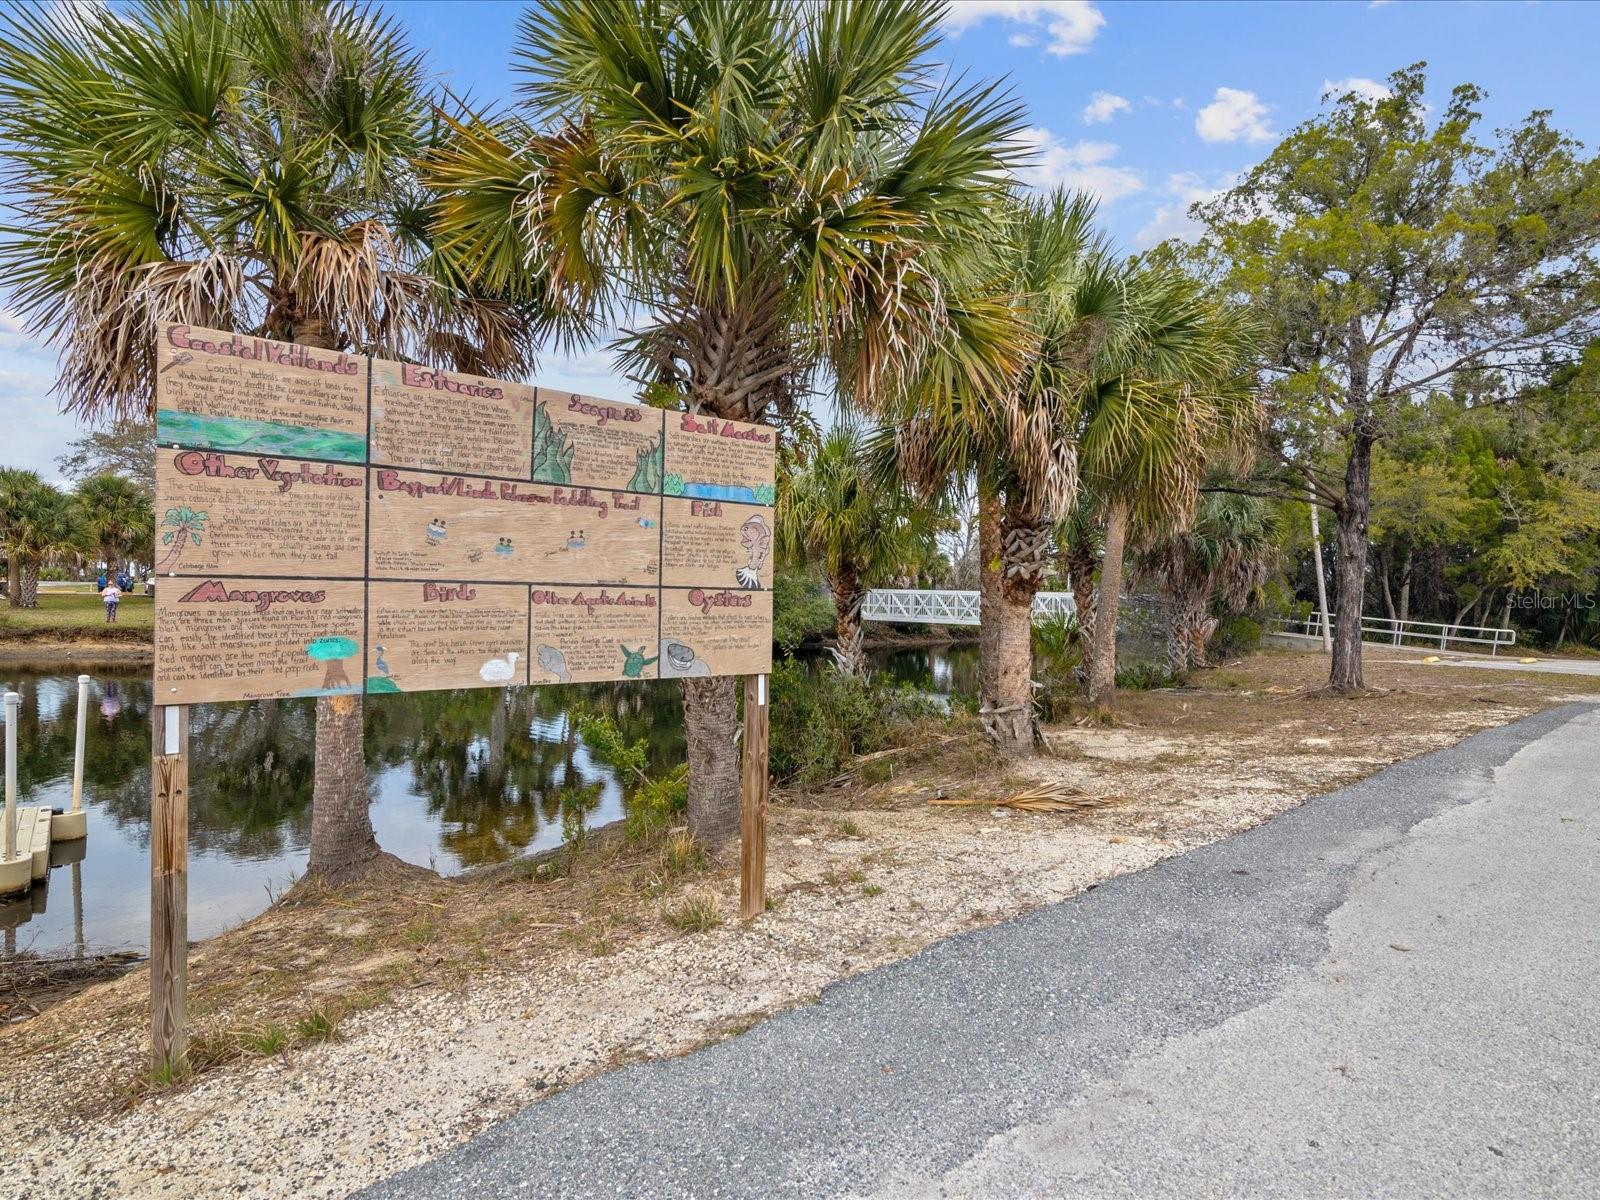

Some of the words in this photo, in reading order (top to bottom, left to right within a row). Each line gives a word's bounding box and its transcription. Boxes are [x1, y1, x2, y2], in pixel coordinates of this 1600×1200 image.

[167, 325, 262, 360] Coastal
[264, 341, 358, 375] Wetlands
[206, 359, 242, 375] Coastal
[249, 369, 278, 381] Wetlands
[295, 378, 311, 386] areas
[314, 378, 320, 387] of
[344, 384, 358, 393] from
[402, 363, 503, 399] Estuaries
[166, 377, 183, 390] They
[220, 386, 234, 394] food
[253, 391, 280, 402] shelter
[166, 387, 188, 396] birds
[214, 394, 234, 402] other
[341, 394, 353, 403] bay
[176, 398, 202, 406] Coastal
[205, 400, 240, 411] Wetlands
[272, 407, 278, 416] of
[568, 394, 642, 426] Seagrass
[680, 413, 718, 434] Salt
[720, 421, 771, 443] Marshes
[388, 451, 402, 463] You
[174, 452, 260, 479] Other
[258, 458, 362, 492] Vegetation
[166, 478, 184, 490] The
[190, 482, 221, 496] cabbage
[225, 506, 234, 514] by
[238, 506, 256, 514] water
[238, 496, 246, 504] It
[255, 499, 276, 509] grows
[280, 498, 292, 507] best
[553, 488, 608, 518] Paddling
[612, 492, 640, 510] Trail
[691, 500, 722, 517] Fish
[210, 522, 224, 530] that
[223, 515, 256, 524] Southern
[210, 530, 243, 538] Christmas
[270, 533, 296, 543] Despite
[211, 540, 230, 548] these
[234, 540, 256, 548] trees
[212, 550, 233, 562] grow
[270, 550, 286, 558] than
[291, 550, 306, 564] they
[179, 562, 204, 570] Cabbage
[178, 580, 326, 612] Mangroves
[423, 582, 476, 602] Birds
[532, 590, 570, 604] Other
[572, 590, 616, 615] Aquatic
[615, 592, 656, 608] Animals
[688, 589, 752, 615] Oysters
[158, 606, 201, 620] Mangroves
[272, 606, 284, 614] that
[159, 616, 176, 625] There
[236, 616, 260, 626] species
[262, 614, 280, 622] found
[159, 624, 178, 632] black
[186, 624, 226, 636] mangroves
[248, 622, 266, 630] white
[310, 620, 328, 628] These
[332, 622, 355, 630] species
[159, 635, 174, 643] can
[180, 632, 202, 643] easily
[222, 632, 254, 640] identified
[258, 630, 278, 639] based
[290, 630, 310, 638] their
[159, 644, 178, 652] and,
[182, 642, 196, 650] like
[201, 641, 216, 650] salt
[220, 641, 256, 650] marshes,
[275, 638, 300, 646] divided
[159, 654, 176, 663] Red
[180, 653, 222, 664] mangroves
[225, 653, 238, 661] are
[241, 650, 254, 660] the
[259, 648, 281, 658] most
[282, 648, 310, 661] popular
[412, 657, 428, 670] along
[431, 656, 440, 664] the
[190, 662, 206, 672] that
[256, 658, 274, 666] along
[277, 657, 288, 665] the
[158, 674, 170, 682] and
[200, 670, 232, 679] identified
[285, 666, 300, 678] prop
